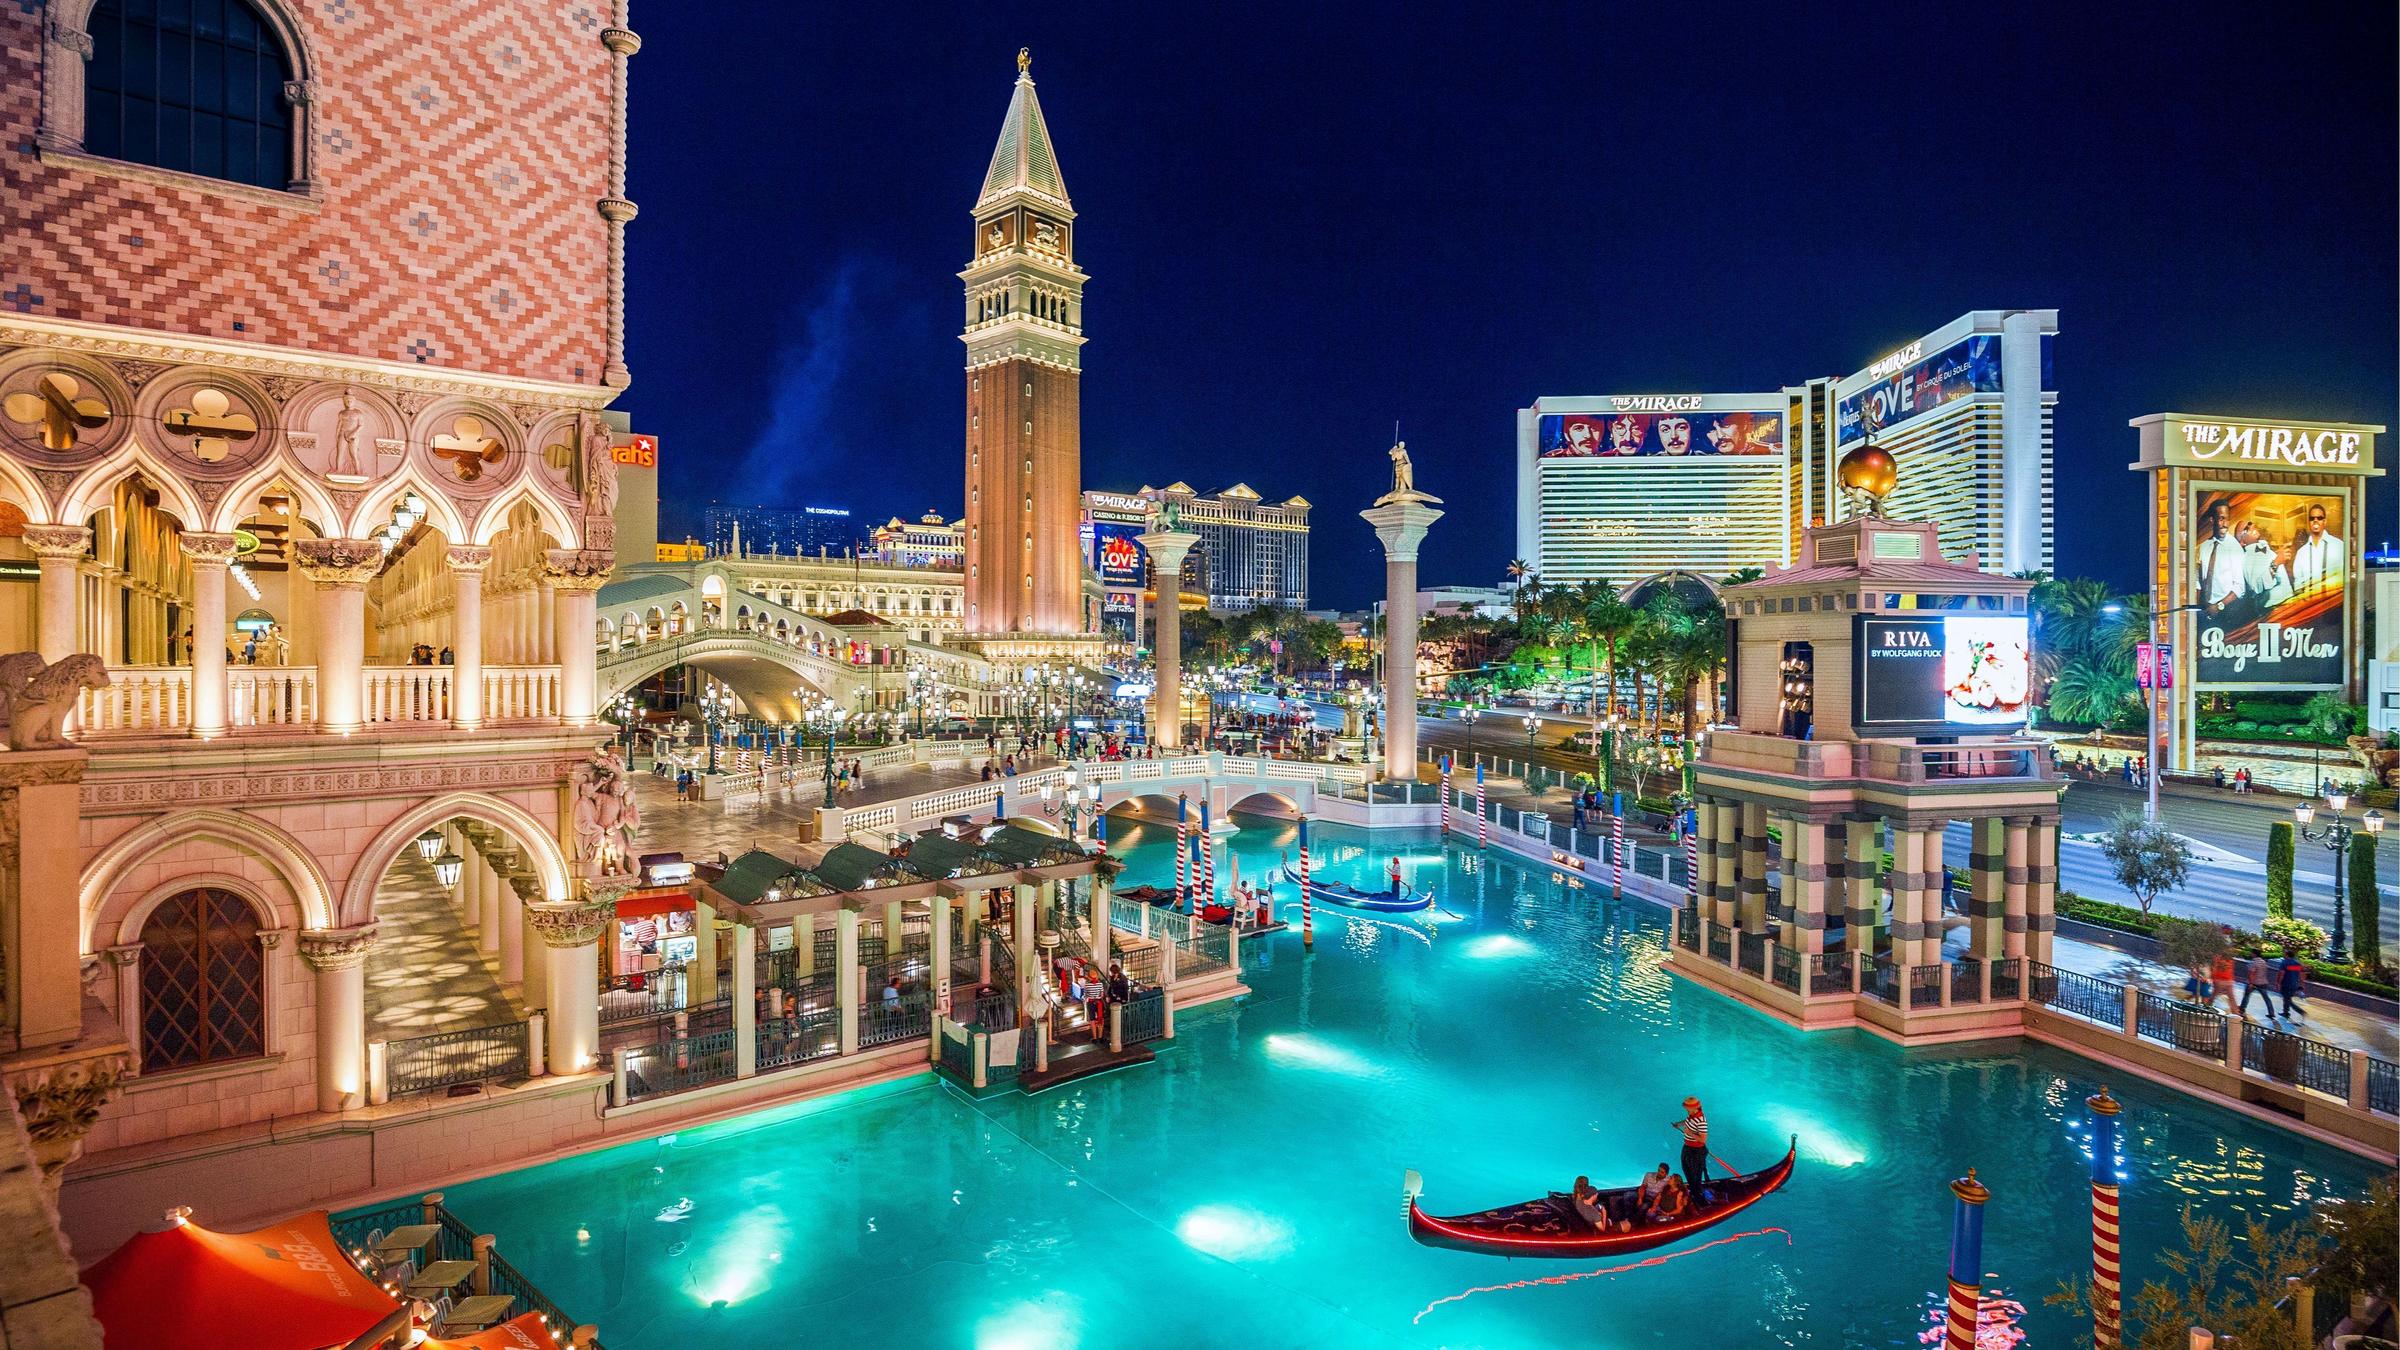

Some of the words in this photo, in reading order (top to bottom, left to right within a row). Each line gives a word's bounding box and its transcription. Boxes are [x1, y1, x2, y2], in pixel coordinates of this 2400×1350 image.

[1873, 342, 1922, 380] MIRAGE
[1611, 397, 1630, 406] THE
[1617, 396, 1702, 412] MIRAGE
[1862, 374, 1915, 430] OVE
[1943, 370, 1953, 380] DU
[2182, 424, 2221, 444] THE
[2191, 426, 2360, 466] MIRAGE
[1095, 496, 1147, 509] MIRAGE
[1093, 511, 1116, 519] CASINO
[1122, 514, 1145, 522] RESORT
[1101, 551, 1139, 568] LOVE
[1884, 631, 1932, 647] RIVA
[1871, 649, 1881, 658] BY
[1881, 649, 1923, 658] WOLFGANG
[1923, 649, 1943, 658] PUCK
[2201, 626, 2258, 673] Boyz
[2257, 622, 2282, 663] II
[2282, 627, 2339, 659] Men
